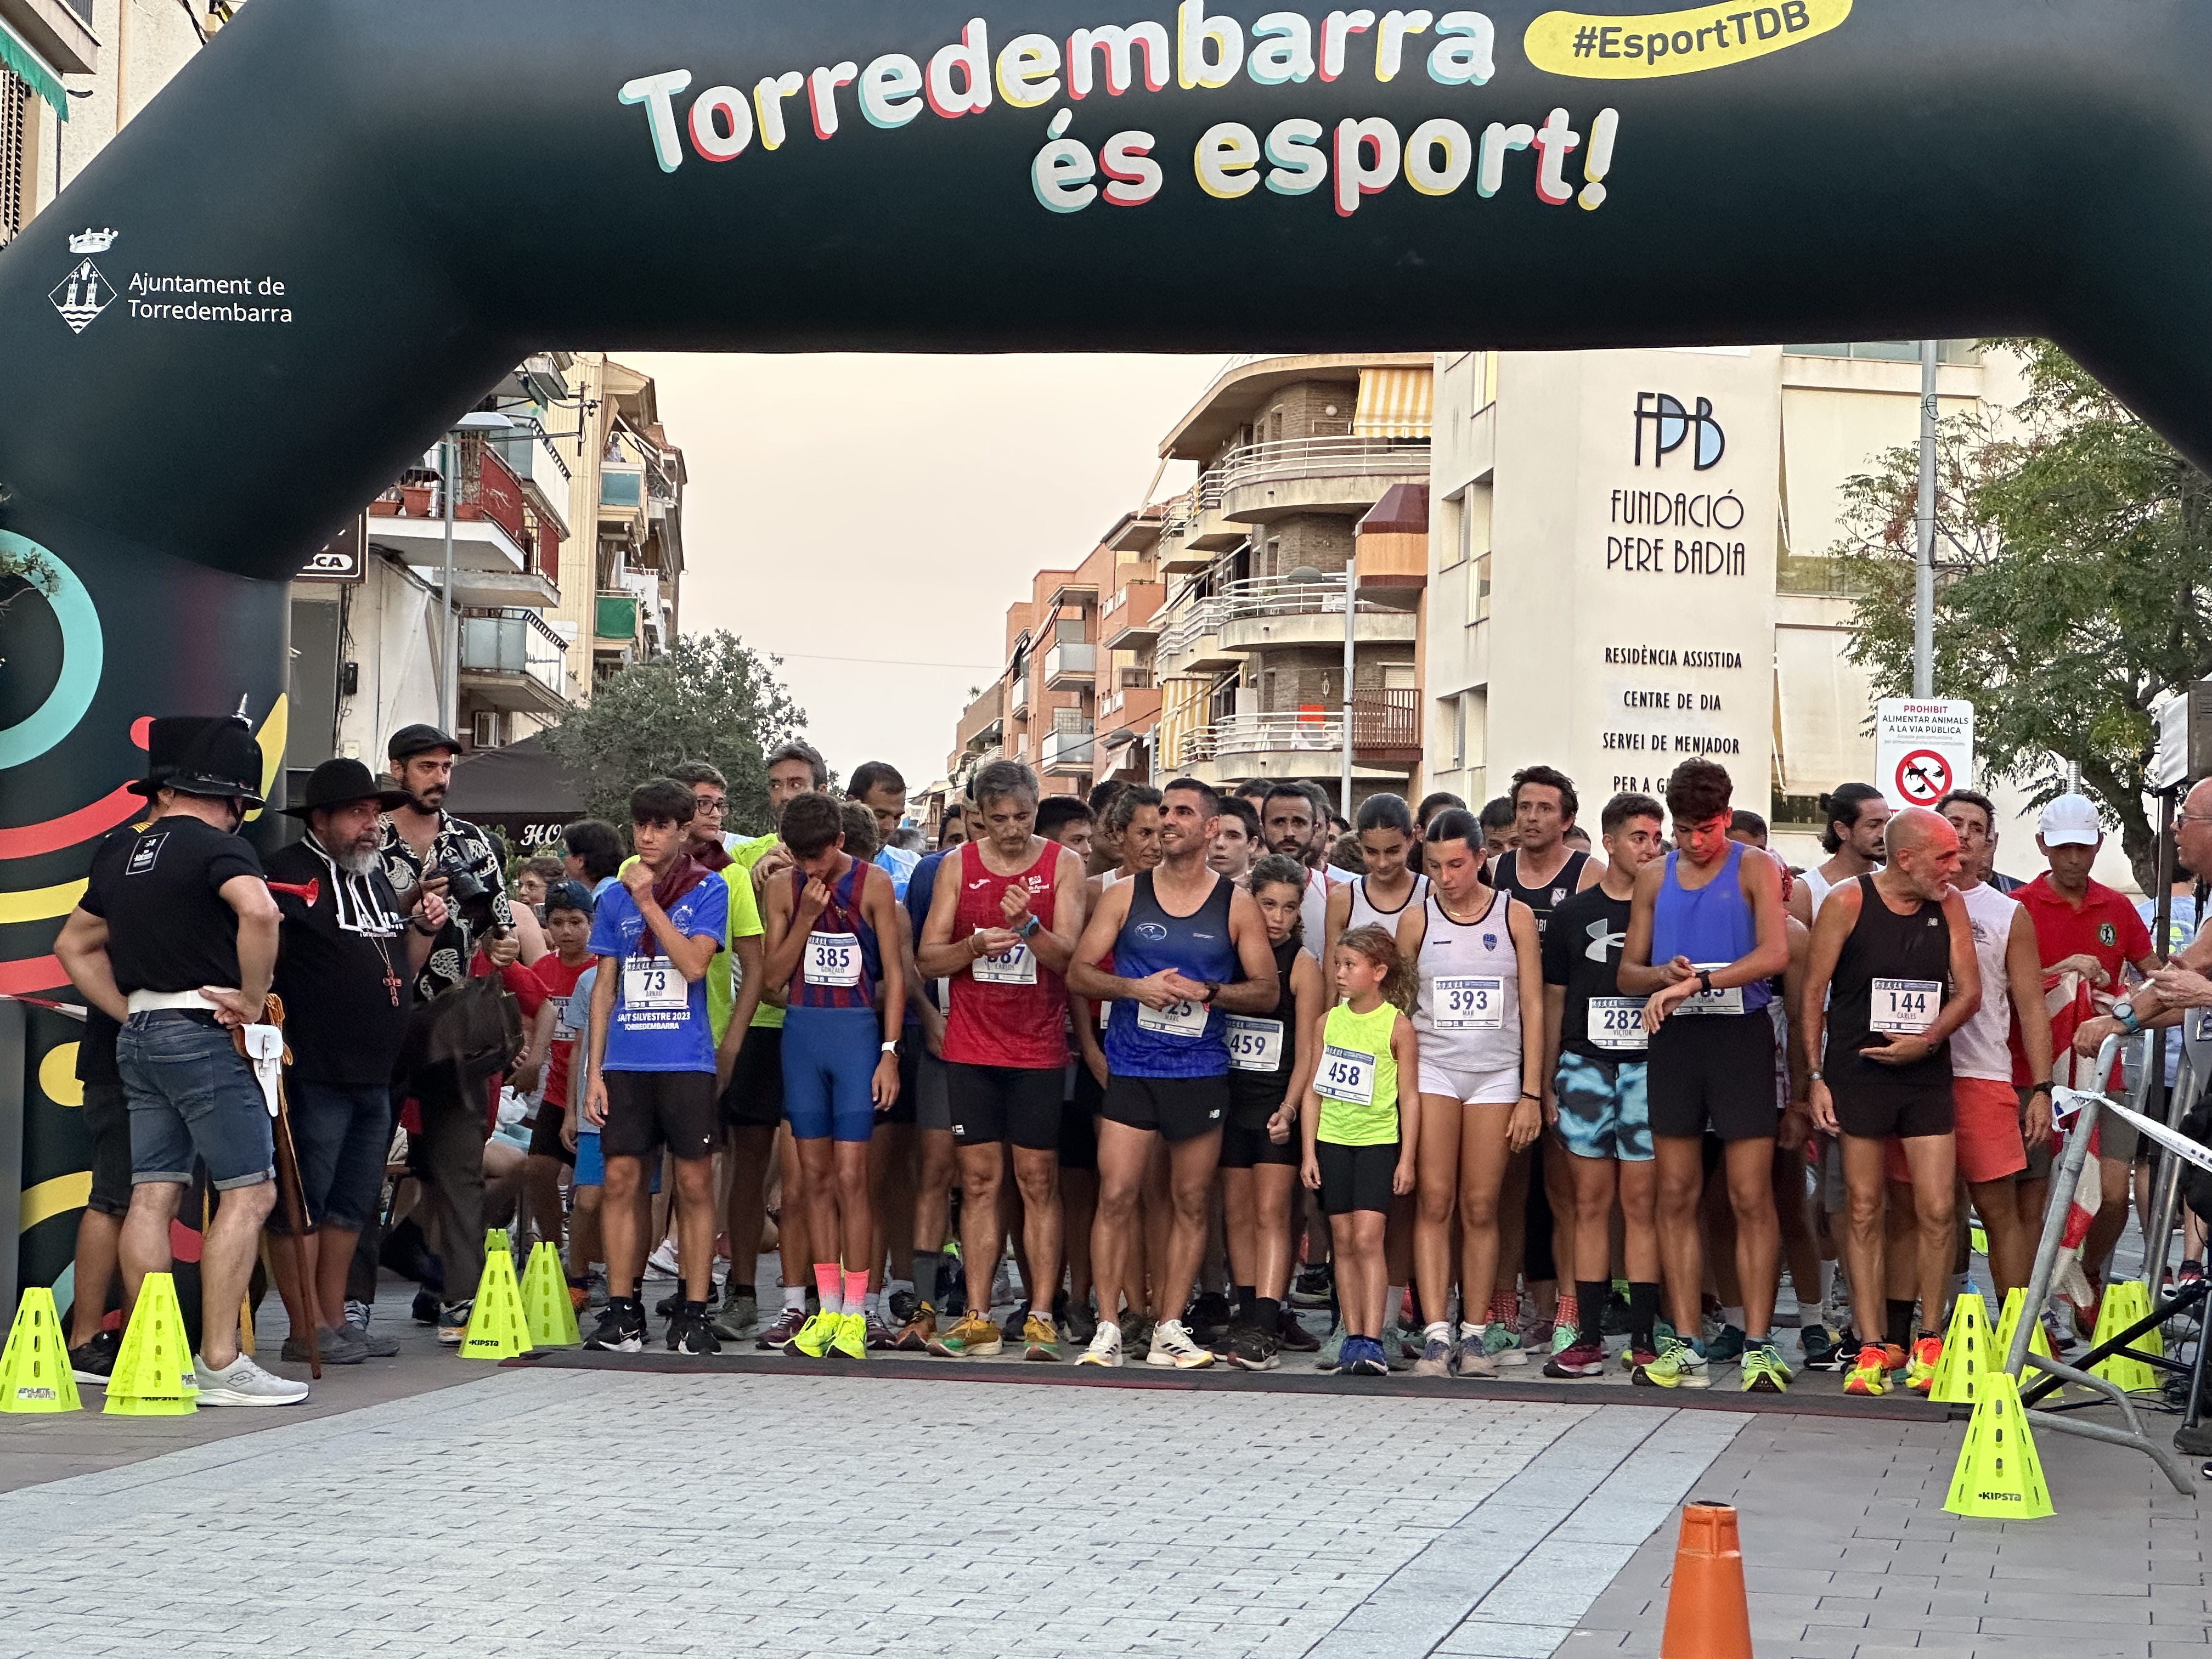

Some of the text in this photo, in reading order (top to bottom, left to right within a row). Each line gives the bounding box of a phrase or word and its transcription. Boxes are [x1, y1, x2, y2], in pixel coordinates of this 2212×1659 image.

[1572, 0, 1810, 65] #EsportTDB
[618, 0, 1496, 173] Torredembarra
[1031, 108, 1618, 217] és esport!
[128, 273, 285, 296] Ajuntament de
[128, 299, 292, 323] Torredembarra
[1633, 391, 1725, 471] FPB
[1611, 488, 1745, 529] FUNDACIÓ
[1607, 536, 1745, 576] PERE BADIA
[1605, 645, 1742, 668] RESIDÈNCIA ASSISTIDA
[1624, 691, 1722, 710] CENTRE DE DIA
[1904, 705, 1948, 714] PROHIBIT
[1882, 715, 1968, 725] ALIMENTAR ANIMALS
[1926, 725, 1961, 734] PÚBLICA
[1602, 732, 1740, 756] SERVEI DE MENJADOR
[1613, 776, 1637, 792] PER
[1643, 777, 1650, 793] A
[816, 947, 850, 967] 385
[644, 970, 665, 991] 73
[1449, 990, 1487, 1010] 393
[1890, 992, 1926, 1013] 144
[632, 1012, 670, 1022] SILVESTRE
[672, 1012, 691, 1020] 2023
[1604, 1010, 1641, 1030] 282
[1229, 1034, 1266, 1056] 459
[1328, 1062, 1361, 1086] 458
